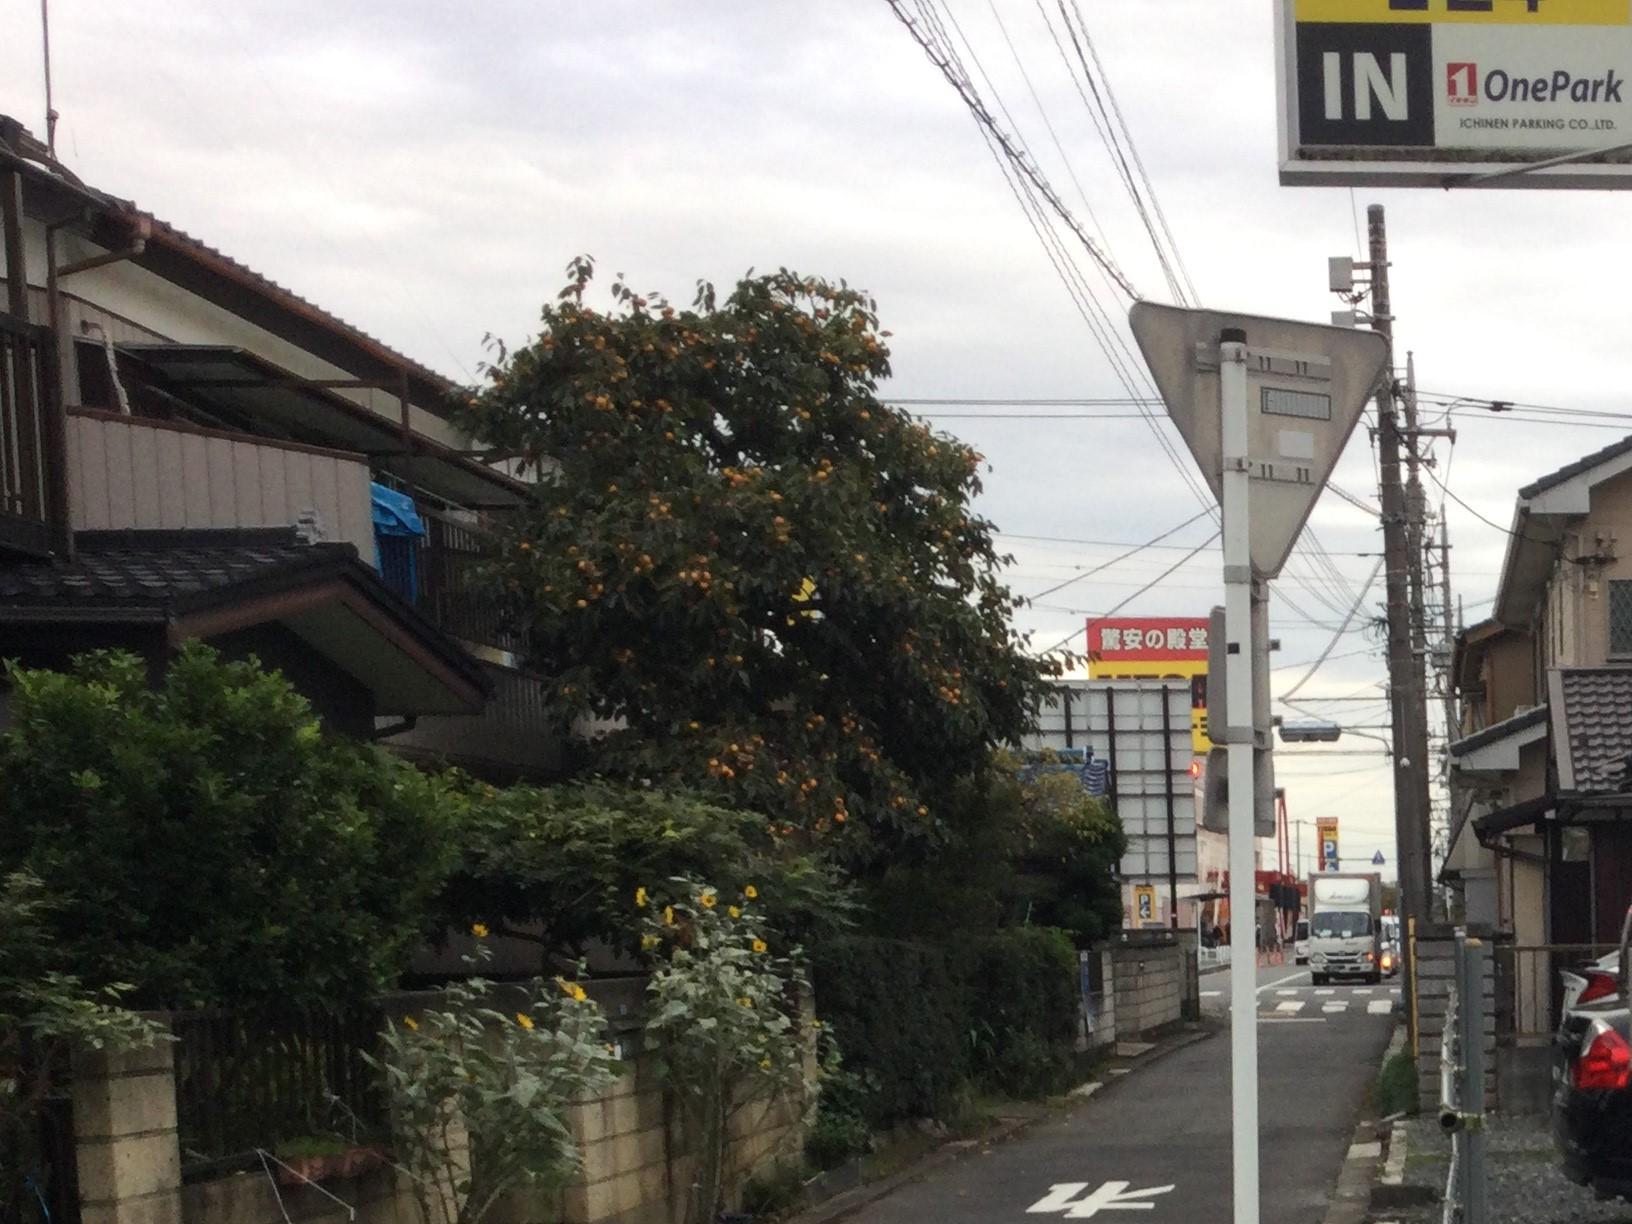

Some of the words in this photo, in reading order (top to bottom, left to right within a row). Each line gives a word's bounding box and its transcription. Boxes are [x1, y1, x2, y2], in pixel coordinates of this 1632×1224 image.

[1322, 51, 1409, 121] IN
[1484, 69, 1625, 103] OnePark
[1459, 117, 1509, 129] ICHINEN
[1512, 118, 1566, 130] PARKING
[1100, 628, 1209, 650] 驚安の殿堂
